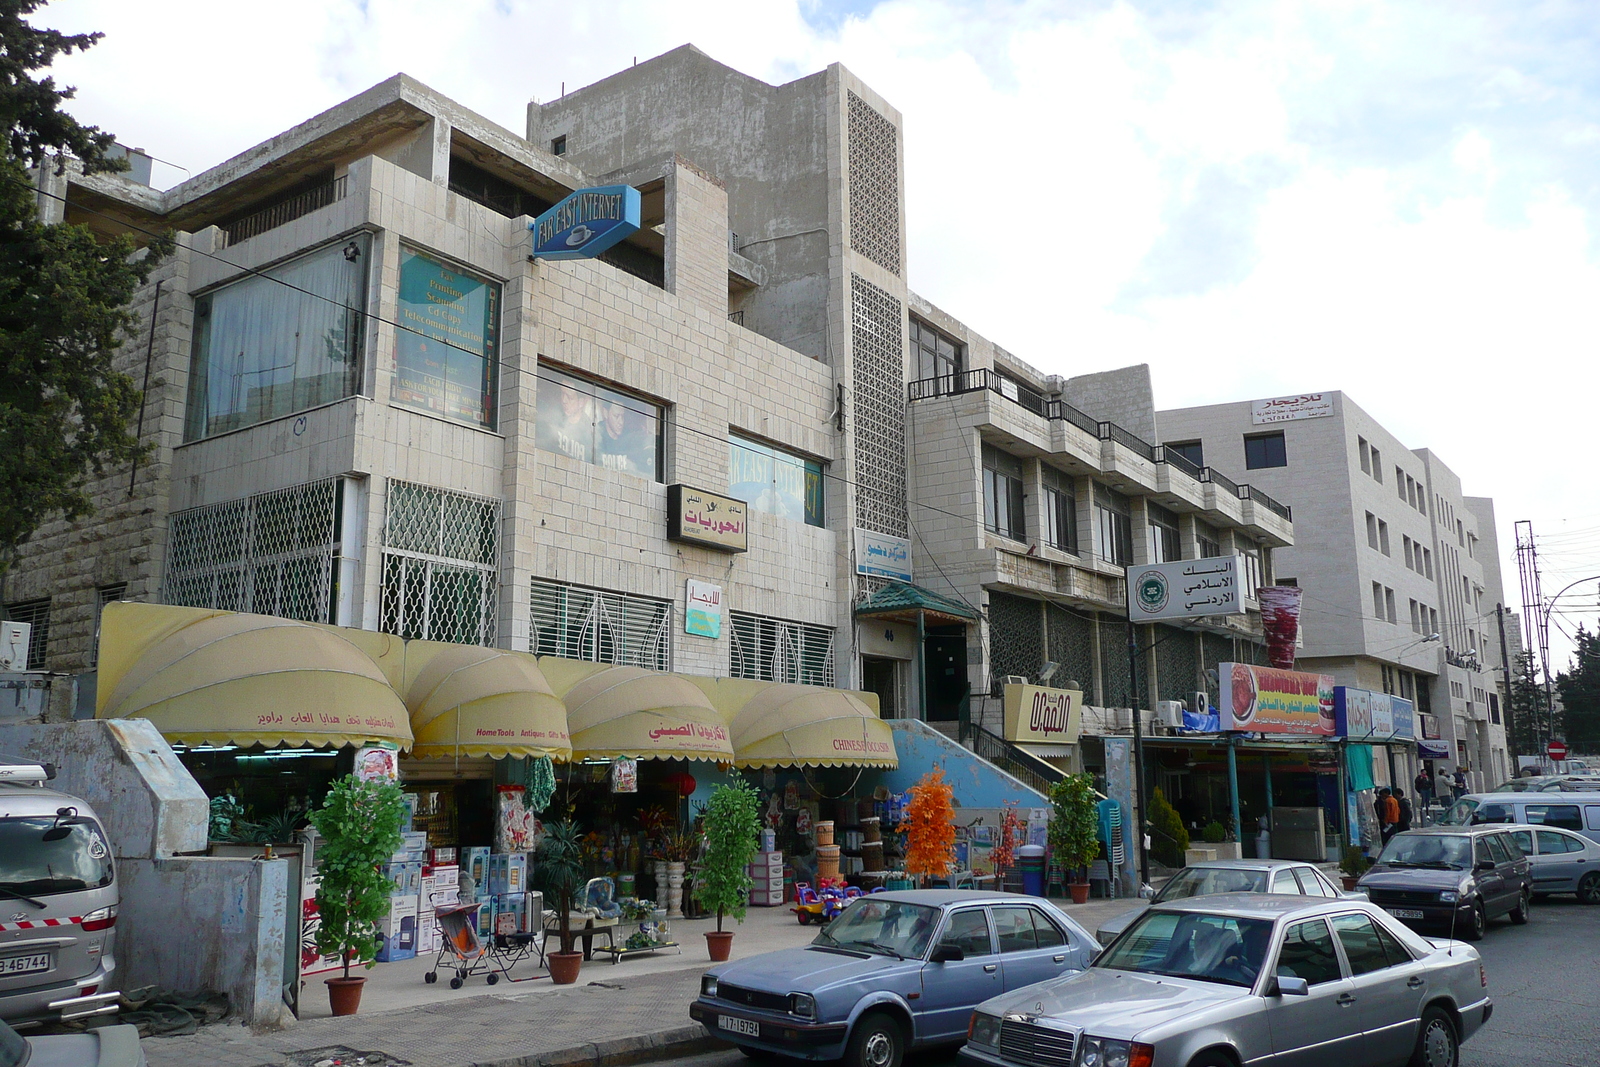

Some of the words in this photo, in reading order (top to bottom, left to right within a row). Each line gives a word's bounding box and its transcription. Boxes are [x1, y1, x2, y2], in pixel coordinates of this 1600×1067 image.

[538, 214, 555, 249] FAR
[556, 196, 577, 234] EAST
[579, 193, 622, 223] INTERNET
[441, 270, 455, 282] Fax
[429, 279, 463, 300] Printing
[426, 291, 465, 314] Scanning
[428, 305, 440, 317] Cd
[441, 310, 461, 325] Copy
[403, 308, 483, 343] Telecommunication
[400, 378, 413, 388] ASK
[1262, 394, 1322, 409] للايجار
[743, 449, 769, 483] EAST
[684, 510, 744, 534] الحوريات
[1182, 562, 1232, 575] البنك
[1184, 577, 1232, 595] الاسلامي
[1185, 592, 1233, 611] الاردني
[884, 629, 894, 642] 46
[291, 712, 314, 725] العاب
[319, 713, 340, 726] هدايا
[476, 728, 497, 736] Home
[497, 728, 515, 737] Tools
[520, 729, 545, 738] Antiques
[648, 722, 695, 742] الصيني
[833, 739, 866, 751] CHINESE
